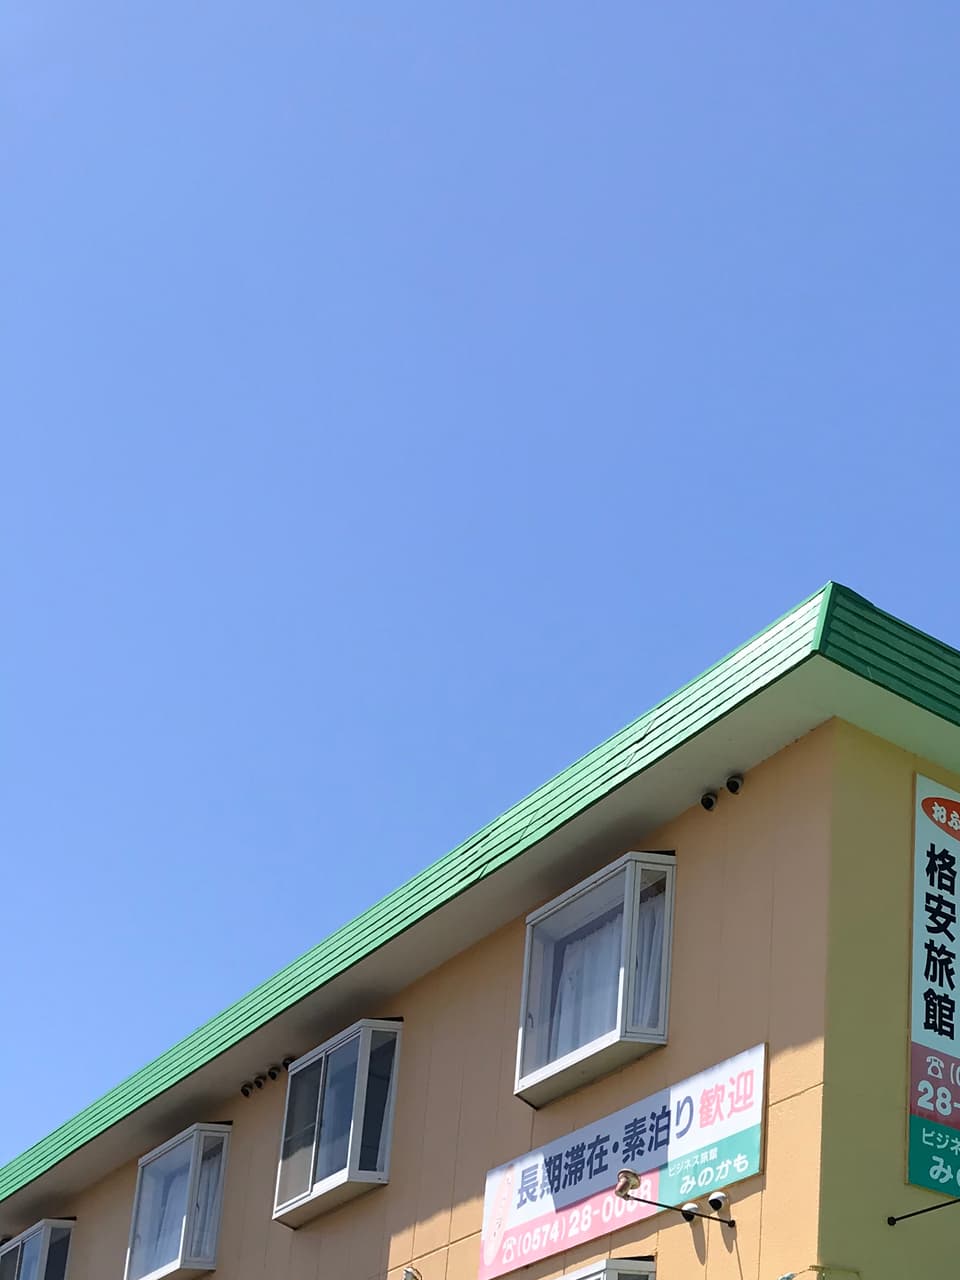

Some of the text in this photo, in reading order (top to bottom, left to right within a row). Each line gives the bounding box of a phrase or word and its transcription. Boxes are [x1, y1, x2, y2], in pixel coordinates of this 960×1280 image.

[924, 842, 958, 1041] 格安旅館
[679, 1153, 749, 1195] みのかも
